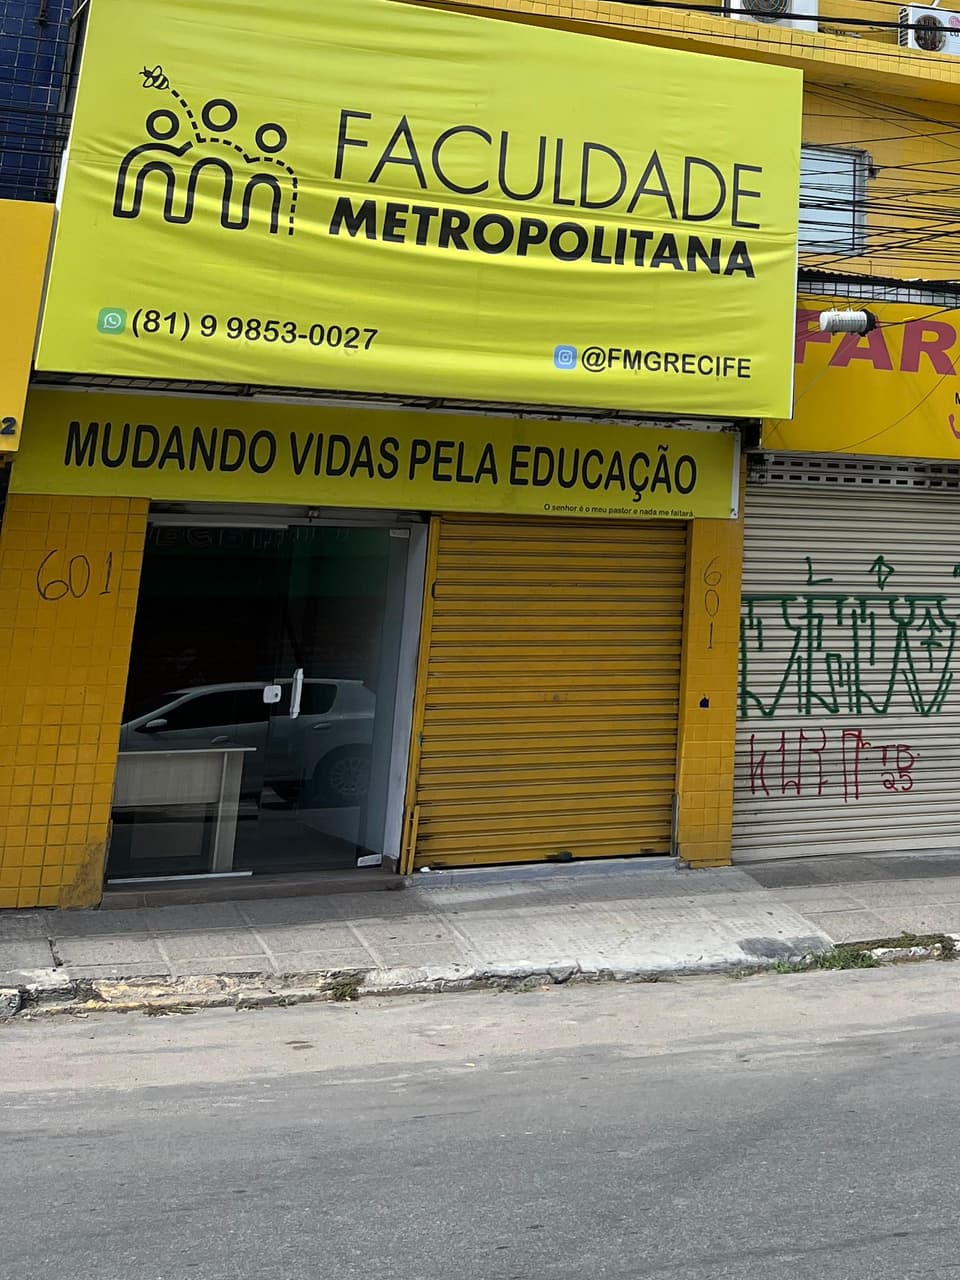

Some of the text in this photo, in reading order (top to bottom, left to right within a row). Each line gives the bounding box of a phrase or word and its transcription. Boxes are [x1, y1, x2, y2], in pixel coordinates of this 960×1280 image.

[334, 108, 763, 230] FACULDADE
[328, 196, 756, 278] METROPOLITANA
[131, 308, 379, 350] (81) 9 9853-0027
[581, 346, 751, 378] @FMGRECIFE
[64, 421, 697, 502] MUDANDO VIDAS PELA EDUCAÇÃO
[543, 503, 551, 511] O
[37, 549, 112, 600] 601
[703, 556, 722, 649] 601
